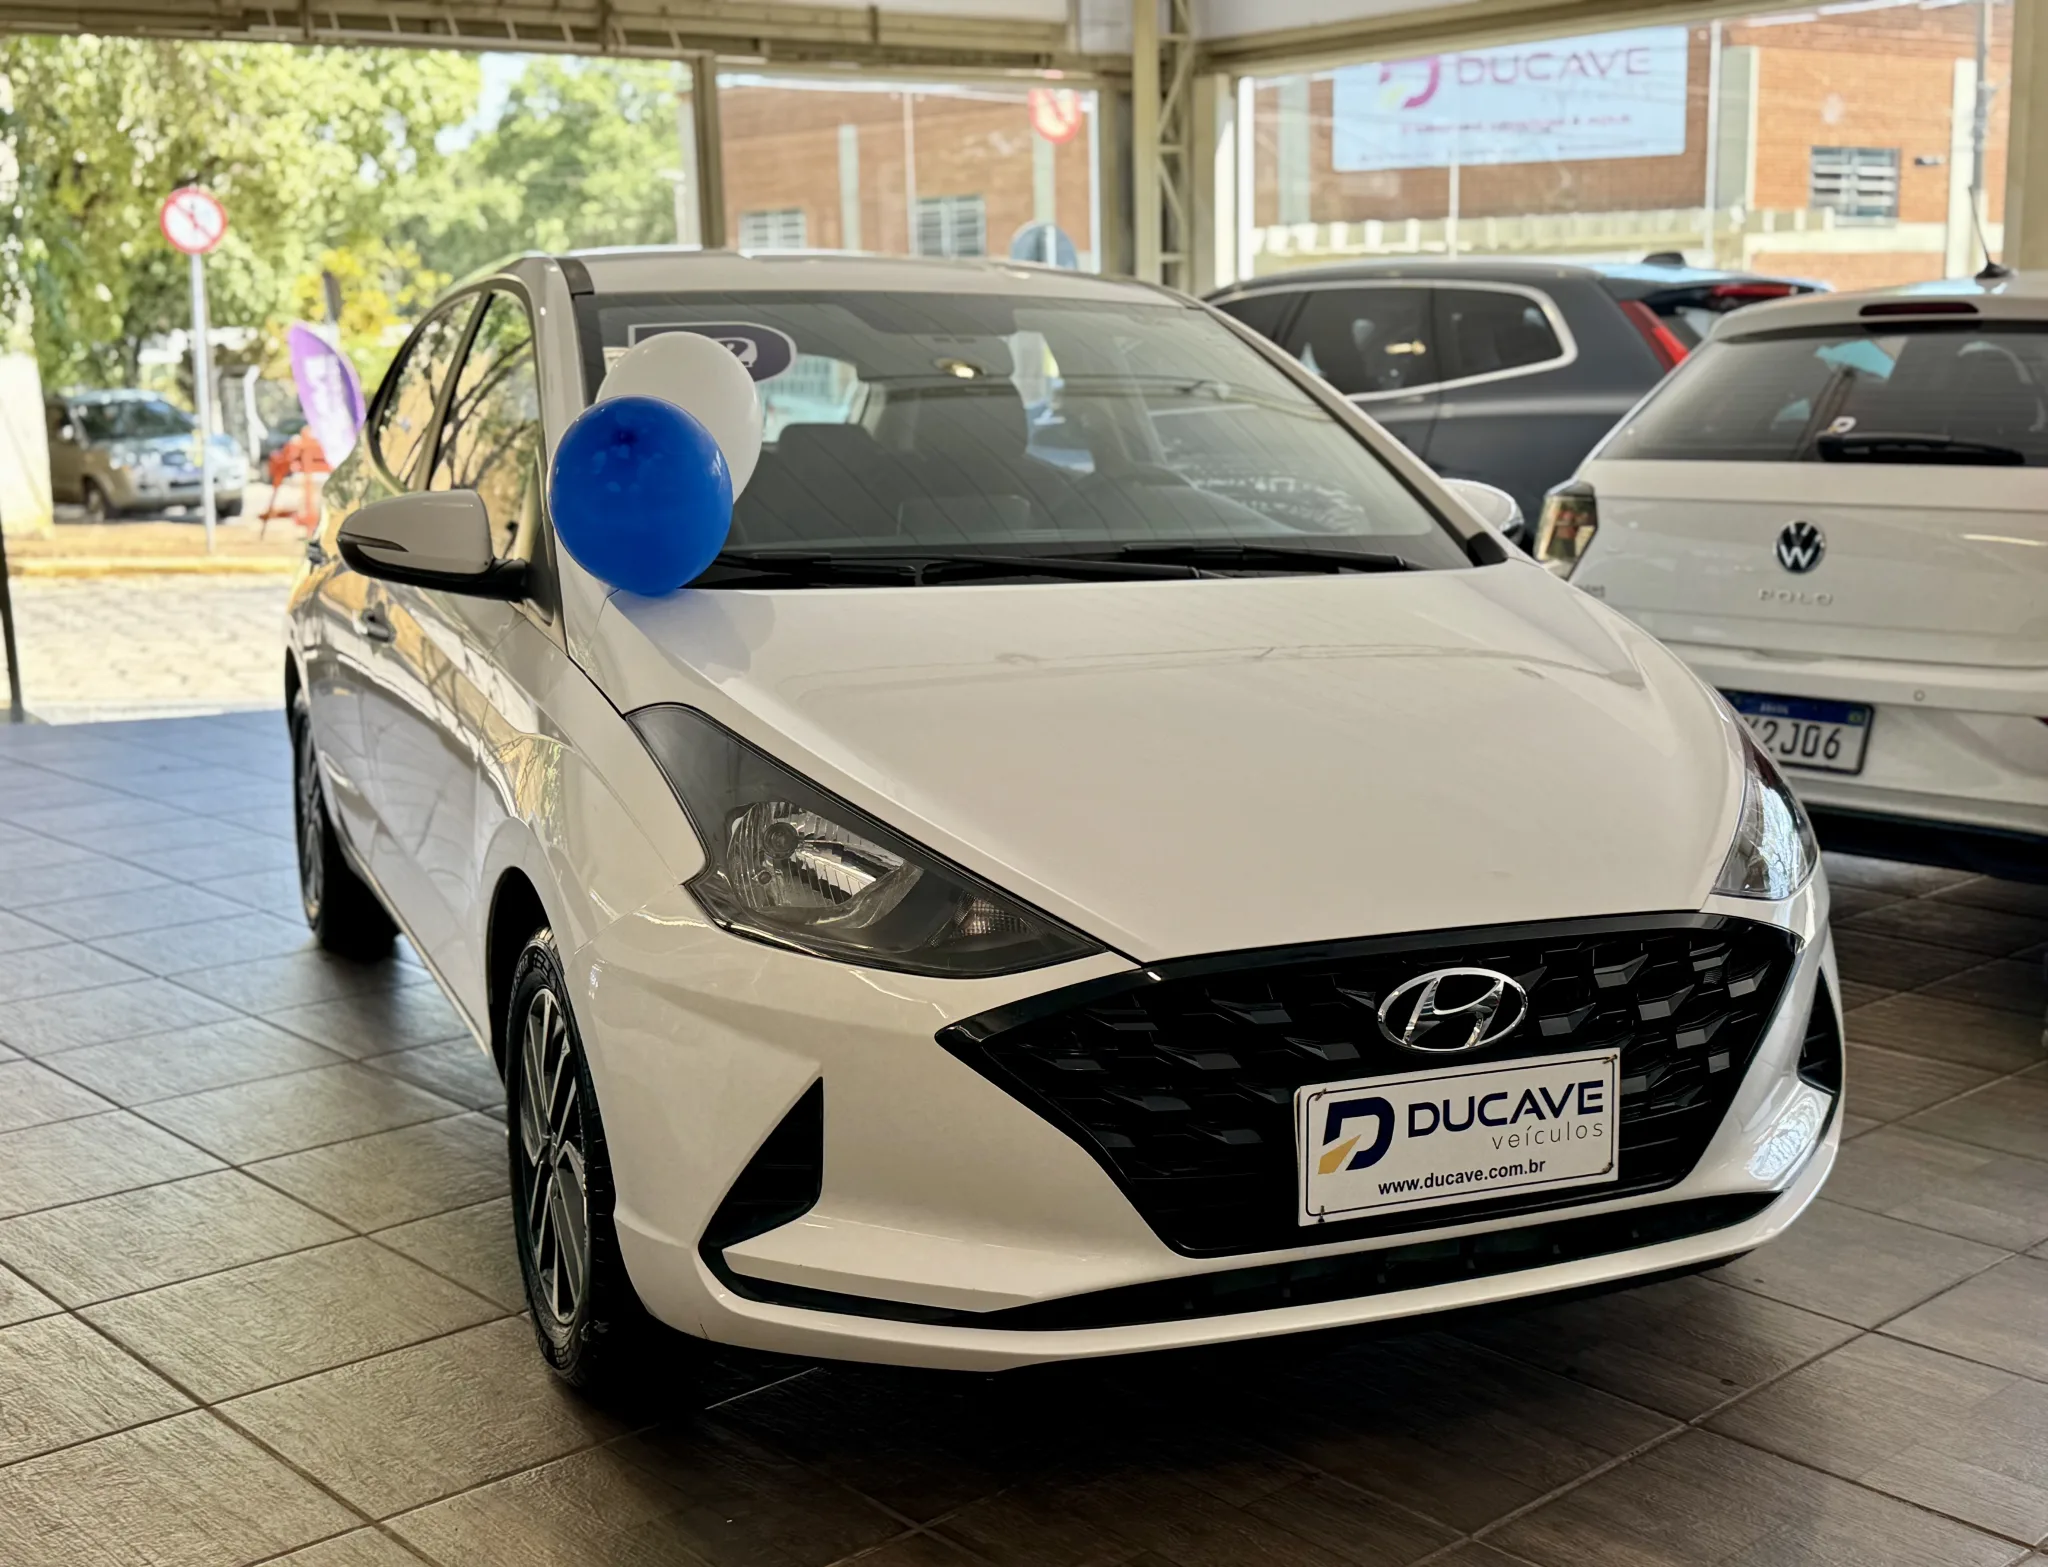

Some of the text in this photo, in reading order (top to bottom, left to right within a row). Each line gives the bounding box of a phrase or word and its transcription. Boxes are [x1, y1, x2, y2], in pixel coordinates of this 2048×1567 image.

[1457, 47, 1653, 85] DUCAVE
[1758, 588, 1833, 606] POLO
[1408, 1080, 1604, 1138] DUCAVE
[1492, 1121, 1603, 1150] veículos
[1378, 1158, 1546, 1195] www.ducave.com.br
